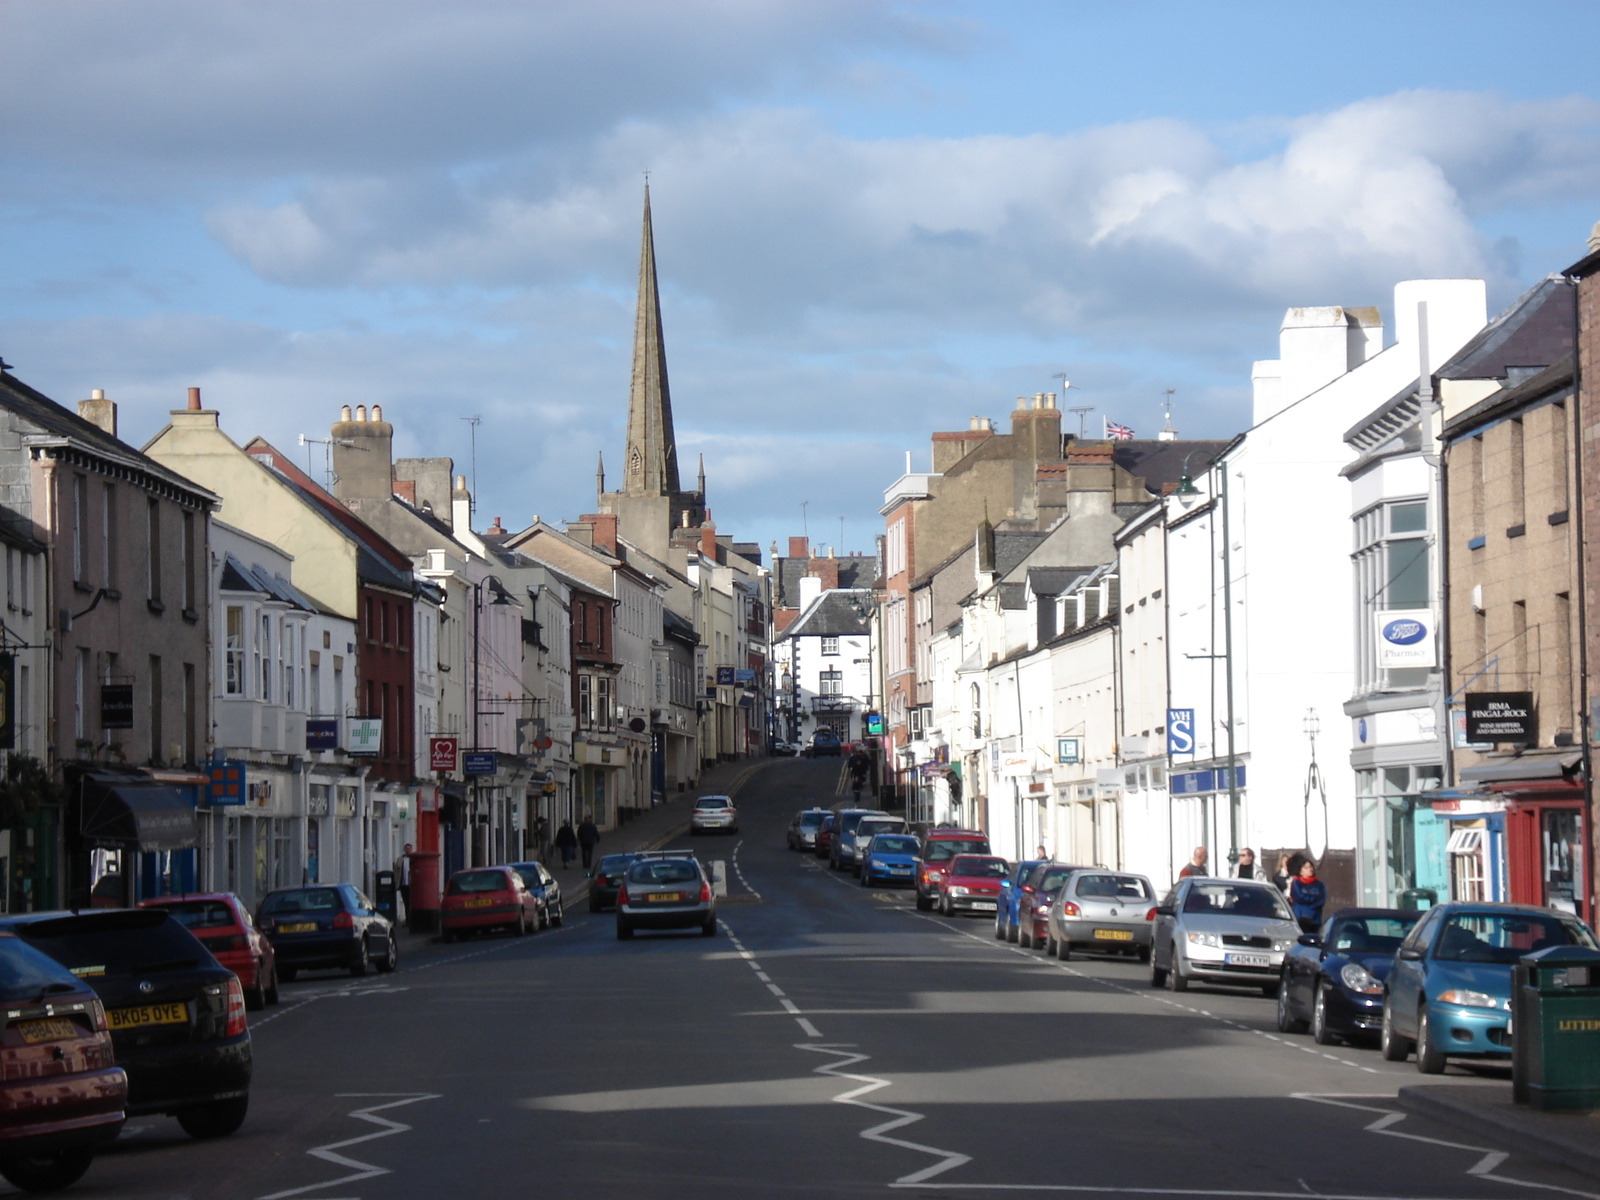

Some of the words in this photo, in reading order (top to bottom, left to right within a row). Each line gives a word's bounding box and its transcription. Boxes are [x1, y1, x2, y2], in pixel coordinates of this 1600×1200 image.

[1389, 623, 1421, 640] Boots
[1385, 648, 1426, 658] Pharmacy
[1488, 702, 1510, 710] IRMA
[1170, 711, 1190, 721] WH
[1472, 709, 1527, 718] FINGAL-ROCK
[1171, 720, 1193, 752] S
[1230, 955, 1251, 963] CA04
[111, 1007, 150, 1026] BK05
[152, 1004, 181, 1021] OYE
